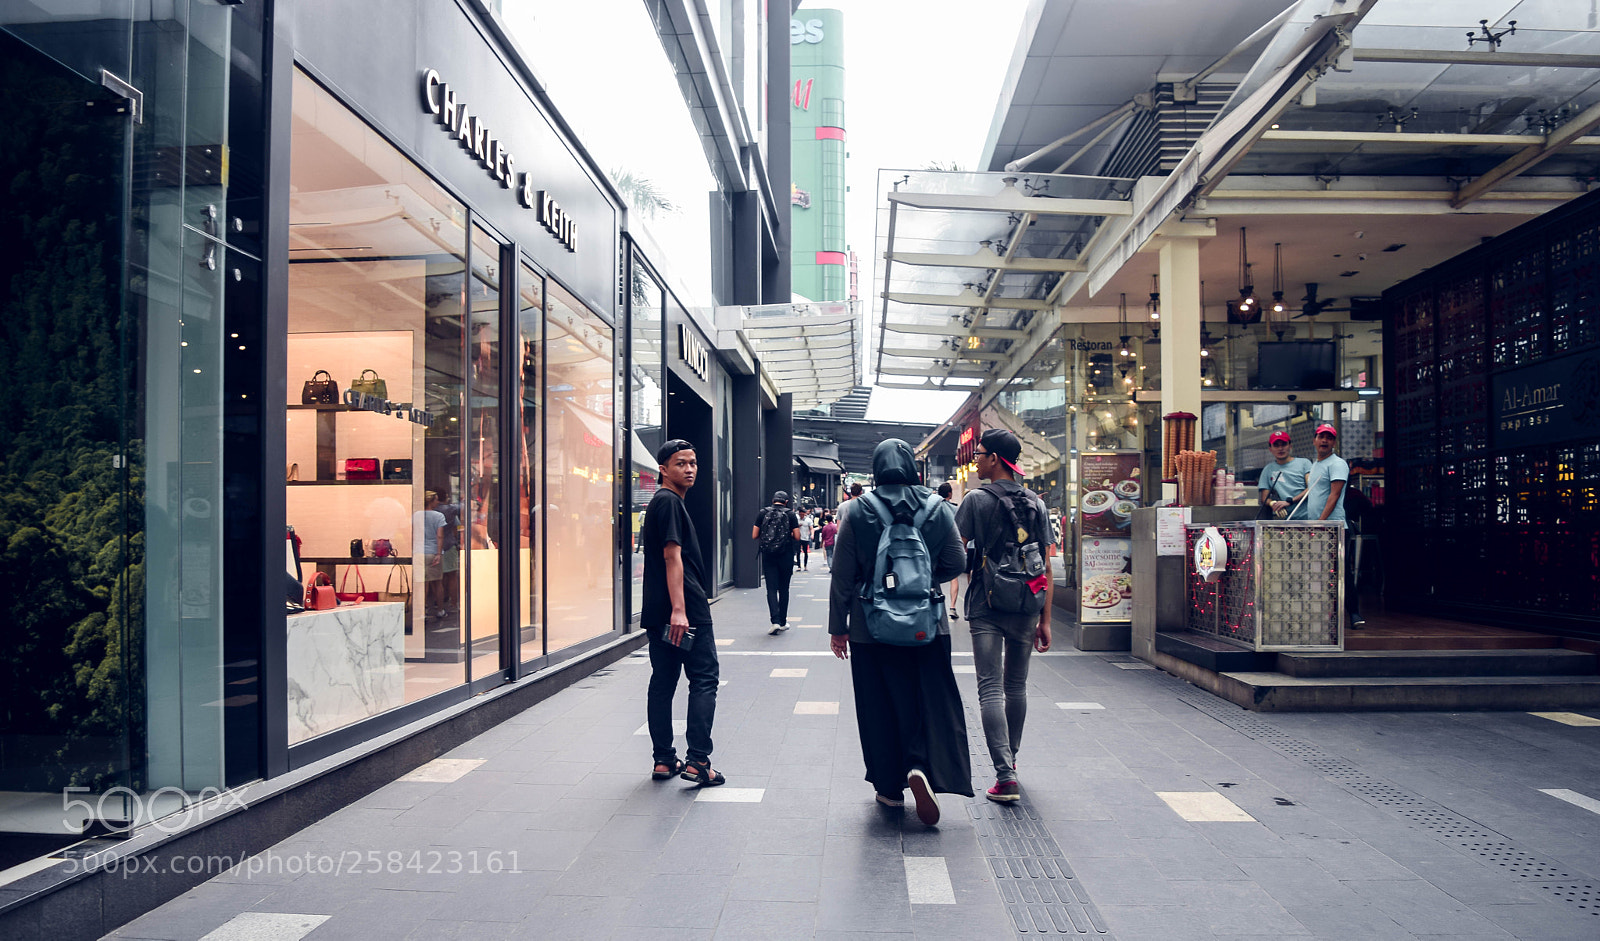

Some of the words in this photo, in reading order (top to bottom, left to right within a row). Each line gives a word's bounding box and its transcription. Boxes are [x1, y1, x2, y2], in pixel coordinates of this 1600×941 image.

[422, 68, 514, 189] CHARLES
[518, 172, 533, 208] &
[538, 190, 578, 252] KEITH
[680, 323, 708, 382] VINCCI
[1070, 339, 1112, 350] Restoran
[1501, 383, 1560, 410] Al-Amar
